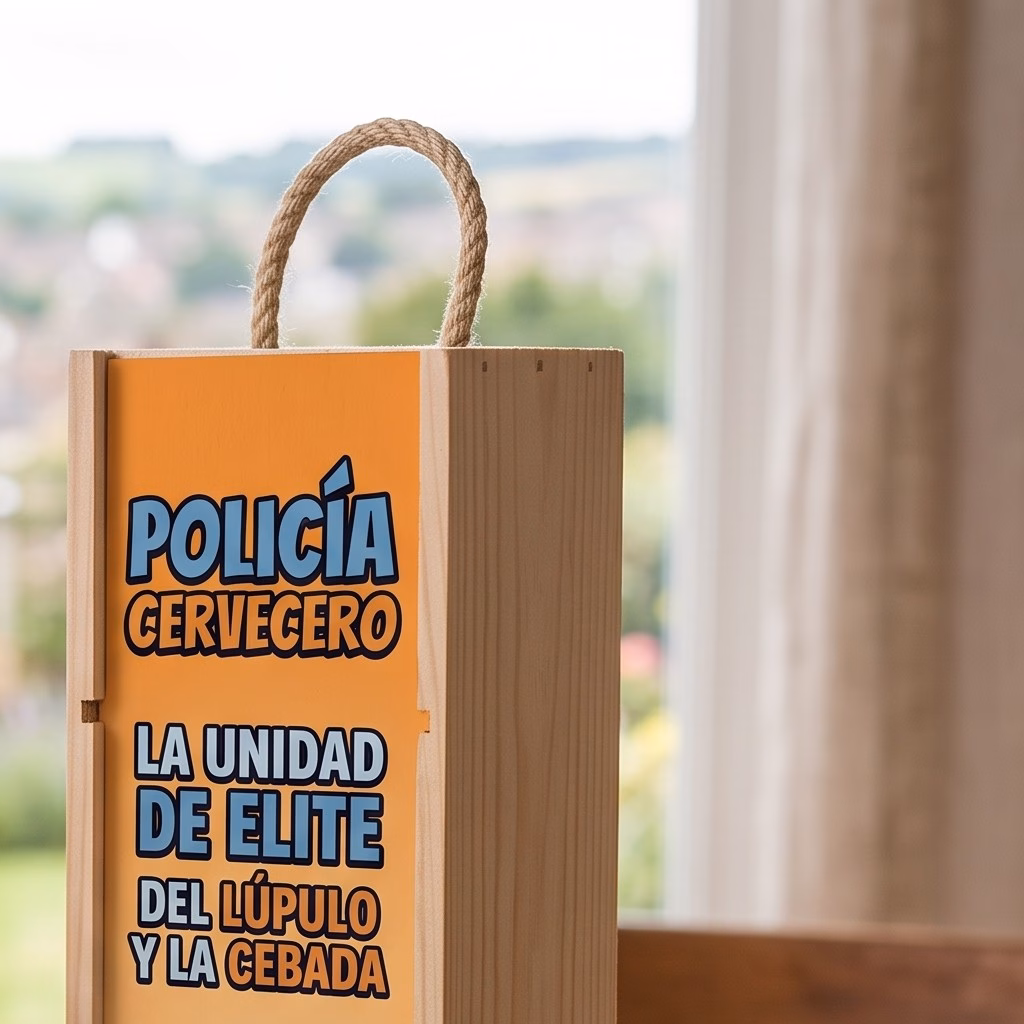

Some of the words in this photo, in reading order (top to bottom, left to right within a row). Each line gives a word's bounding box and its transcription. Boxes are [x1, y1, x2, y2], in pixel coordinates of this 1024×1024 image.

[126, 455, 399, 585] POLICÍA
[124, 590, 402, 660] CERVECERO
[134, 722, 194, 781] LA
[203, 724, 388, 787] UNIDAD
[136, 785, 212, 861] DE
[226, 788, 384, 869] ELITE
[137, 876, 213, 930] DEL
[219, 869, 381, 941] LÚPULO
[128, 932, 161, 985] Y
[166, 933, 220, 988] LA
[225, 938, 390, 1000] CEBADA
